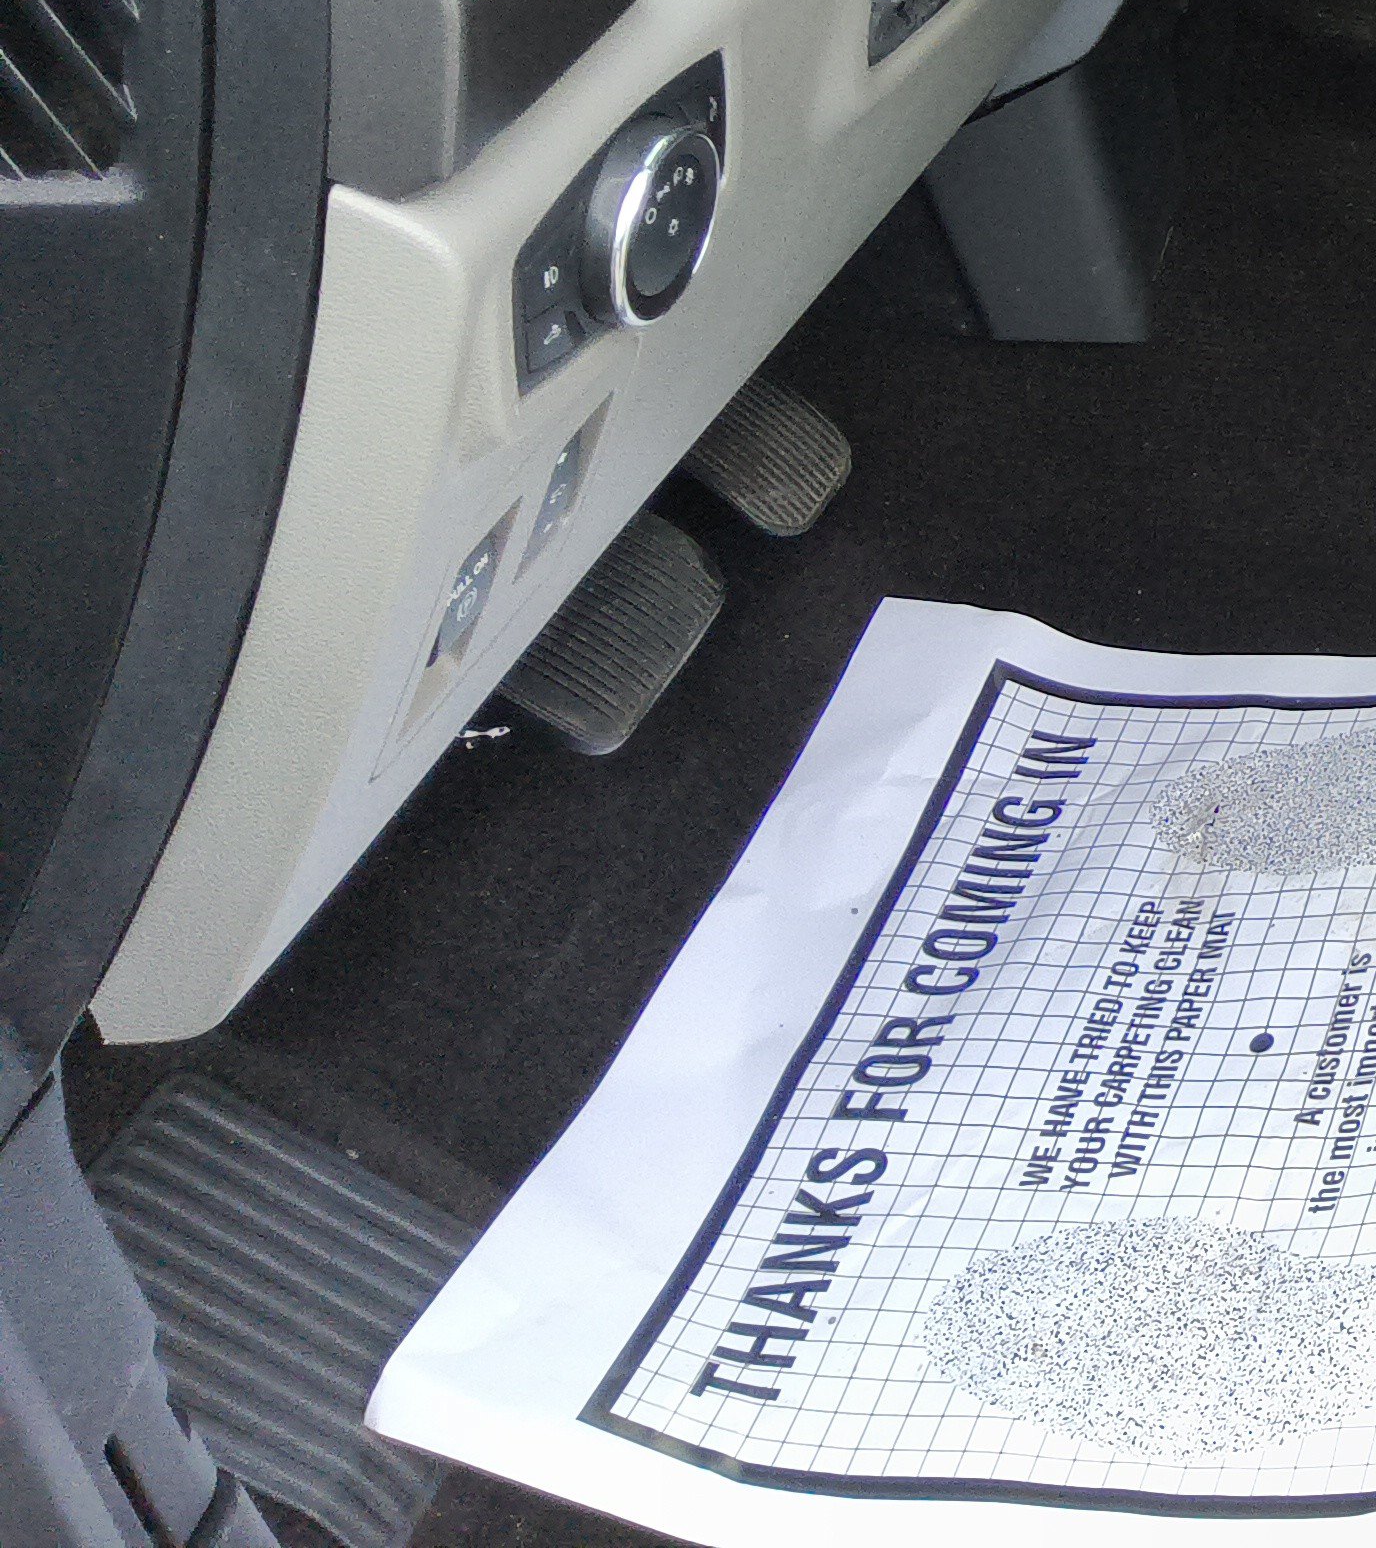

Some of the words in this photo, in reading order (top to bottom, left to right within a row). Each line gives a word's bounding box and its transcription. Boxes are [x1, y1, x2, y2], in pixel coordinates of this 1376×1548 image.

[1119, 900, 1165, 955] KEEP
[1103, 960, 1140, 990] TO
[1341, 951, 1372, 977] is
[1060, 1116, 1114, 1191] YOUR
[1094, 978, 1174, 1107] CARPETING
[1153, 899, 1205, 971] CLEAN
[1069, 998, 1124, 1064] TRIED
[1308, 984, 1363, 1101] customer
[690, 1147, 888, 1401] THANKS
[831, 1013, 957, 1122] FOR
[903, 795, 1068, 996] COMING
[1013, 729, 1097, 780] IN
[1109, 1100, 1160, 1179] WITH
[1138, 1048, 1186, 1101] THIS
[1165, 966, 1218, 1042] PAPER
[1040, 1069, 1091, 1138] HAVE
[1294, 1107, 1324, 1127] A
[1019, 1145, 1062, 1187] WE
[1308, 1170, 1345, 1214] the
[1330, 1093, 1369, 1161] most
